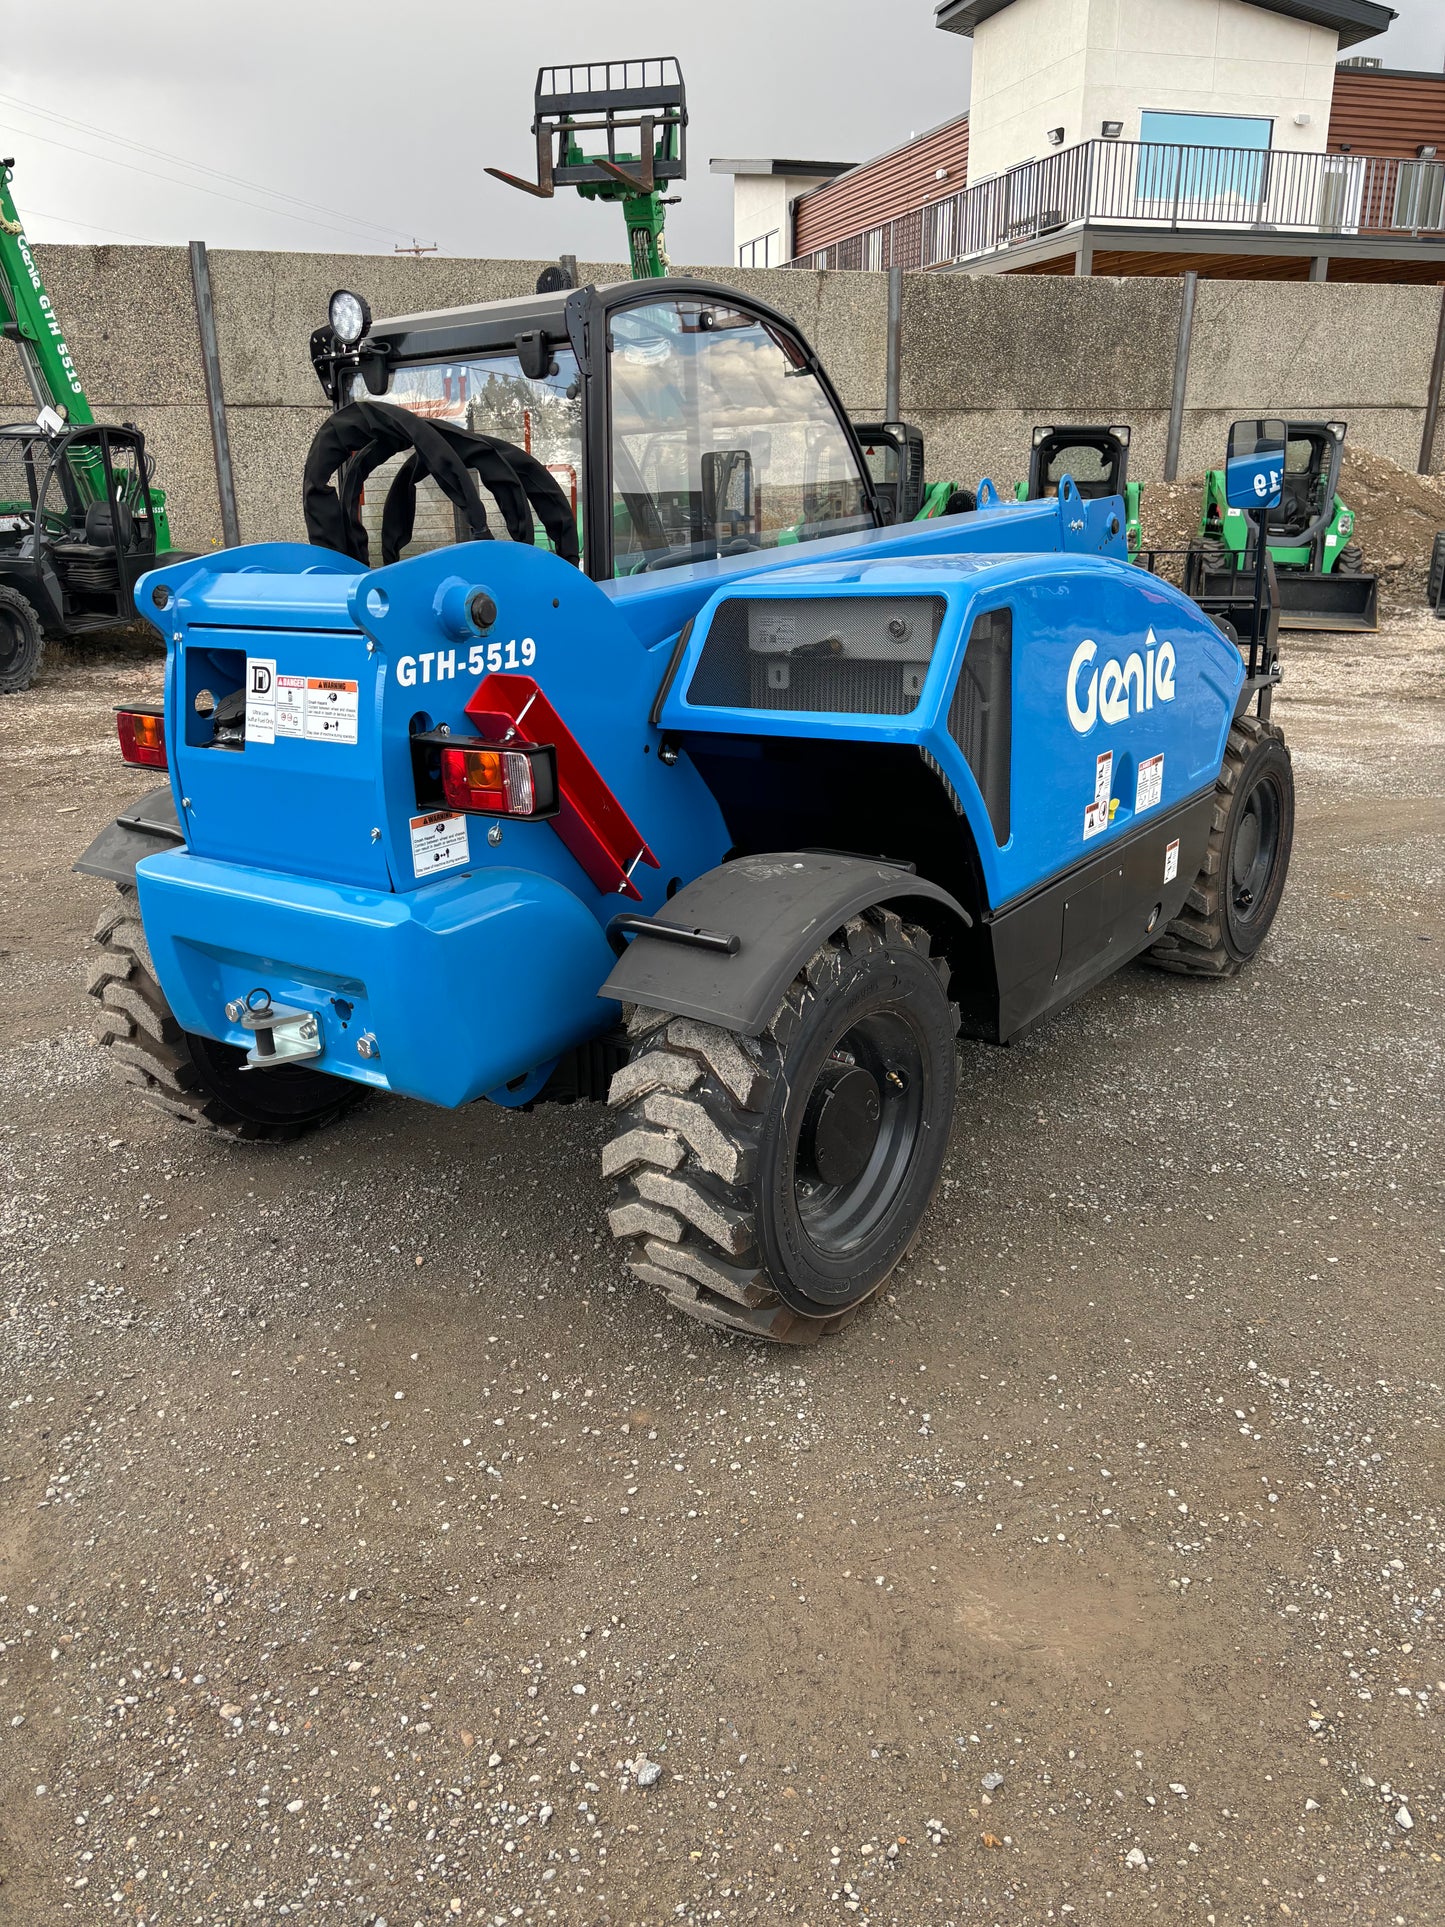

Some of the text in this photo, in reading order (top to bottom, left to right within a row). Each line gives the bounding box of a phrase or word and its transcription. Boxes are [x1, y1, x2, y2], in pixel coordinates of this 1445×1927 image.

[17, 234, 41, 290] Genie
[38, 295, 82, 393] GTH 5519
[283, 678, 304, 688] DANGER
[323, 681, 346, 690] WARNING
[396, 637, 536, 687] GTH-5519
[1066, 627, 1176, 733] Genie
[429, 812, 453, 824] WARNING
